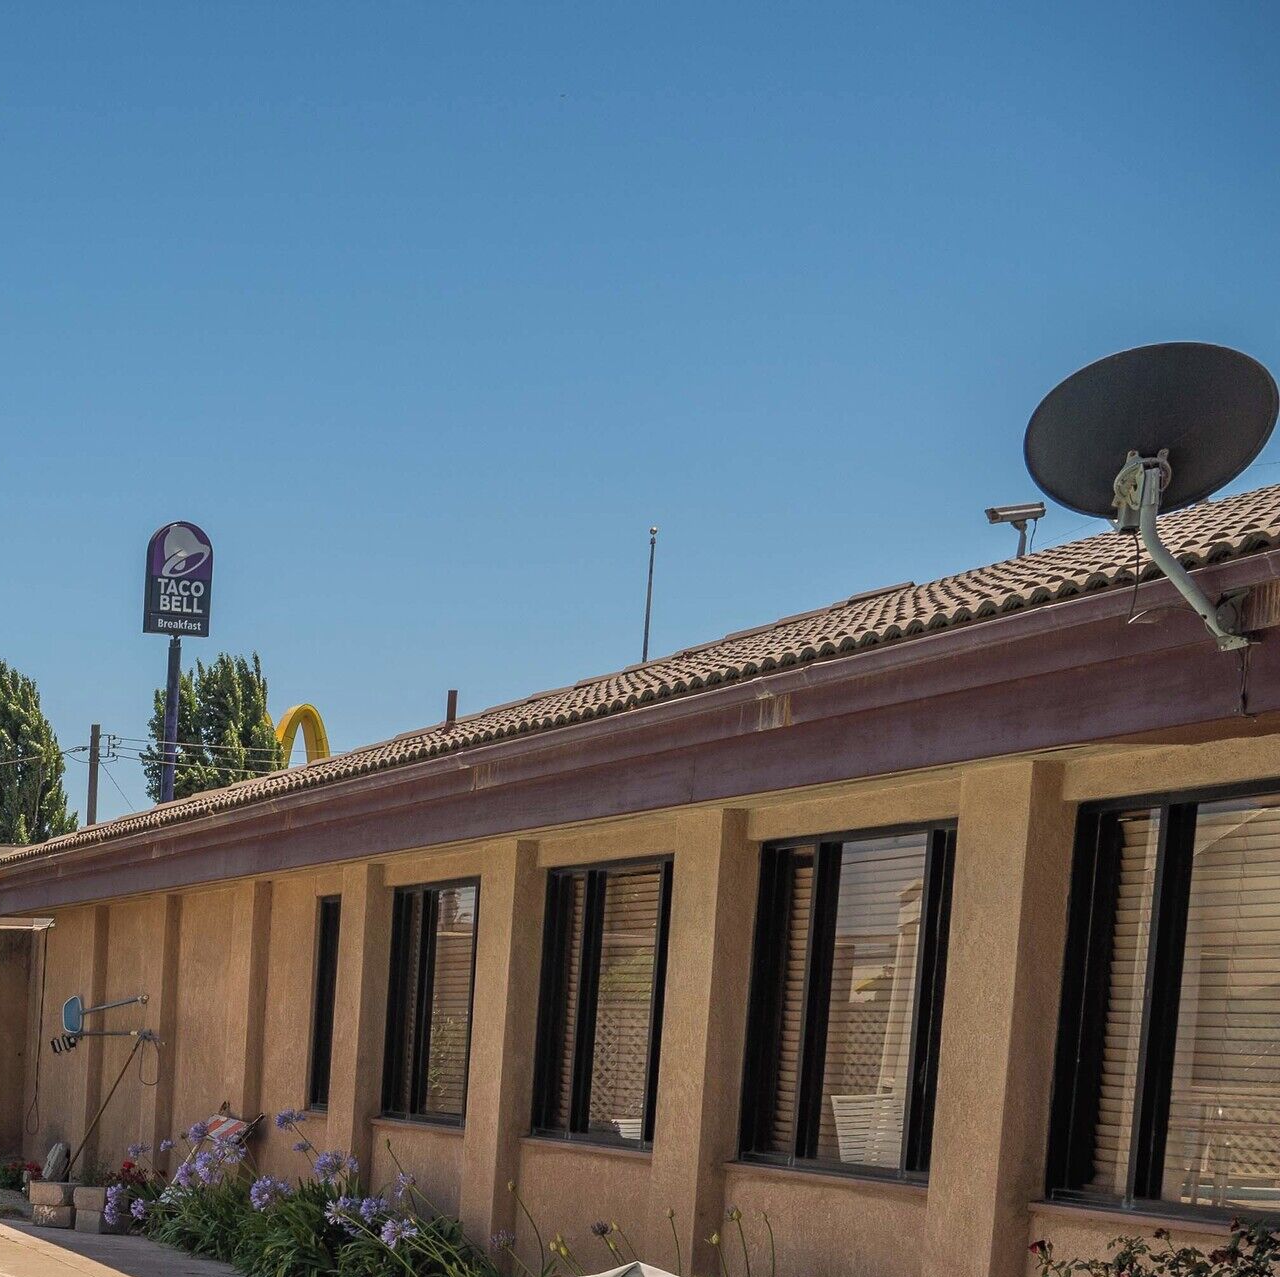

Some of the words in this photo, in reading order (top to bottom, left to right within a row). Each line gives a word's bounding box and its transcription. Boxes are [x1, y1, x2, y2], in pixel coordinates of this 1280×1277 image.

[158, 578, 204, 597] TACO
[160, 595, 203, 613] BELL
[158, 619, 202, 631] Breakfast
